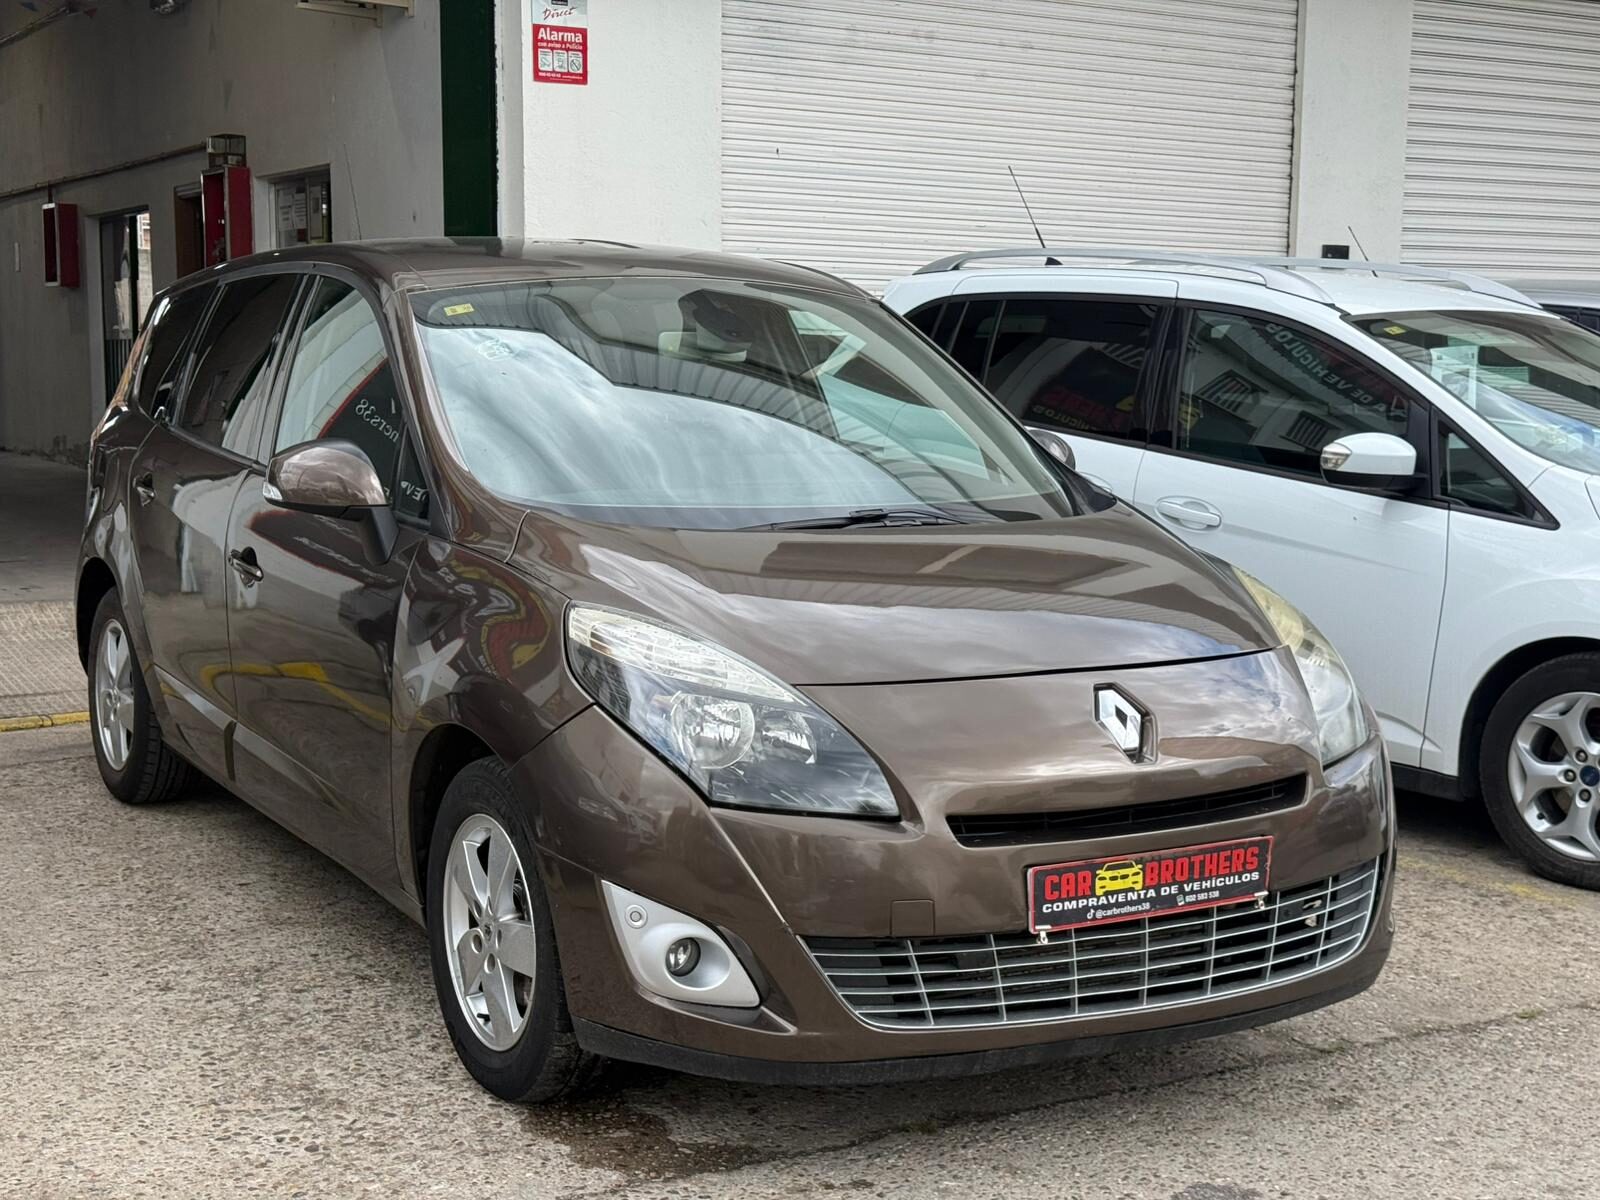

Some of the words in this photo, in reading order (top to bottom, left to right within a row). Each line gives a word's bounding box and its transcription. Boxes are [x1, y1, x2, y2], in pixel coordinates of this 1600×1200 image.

[543, 6, 577, 20] Direct
[538, 27, 583, 42] Alarma
[1044, 870, 1092, 901] CAR
[1144, 846, 1260, 887] BROTHERS
[1042, 890, 1157, 913] COMPRAVENTA
[1161, 885, 1180, 896] DE
[1183, 871, 1260, 892] VEHÍCULOS
[1095, 902, 1151, 919] @carbrothers38
